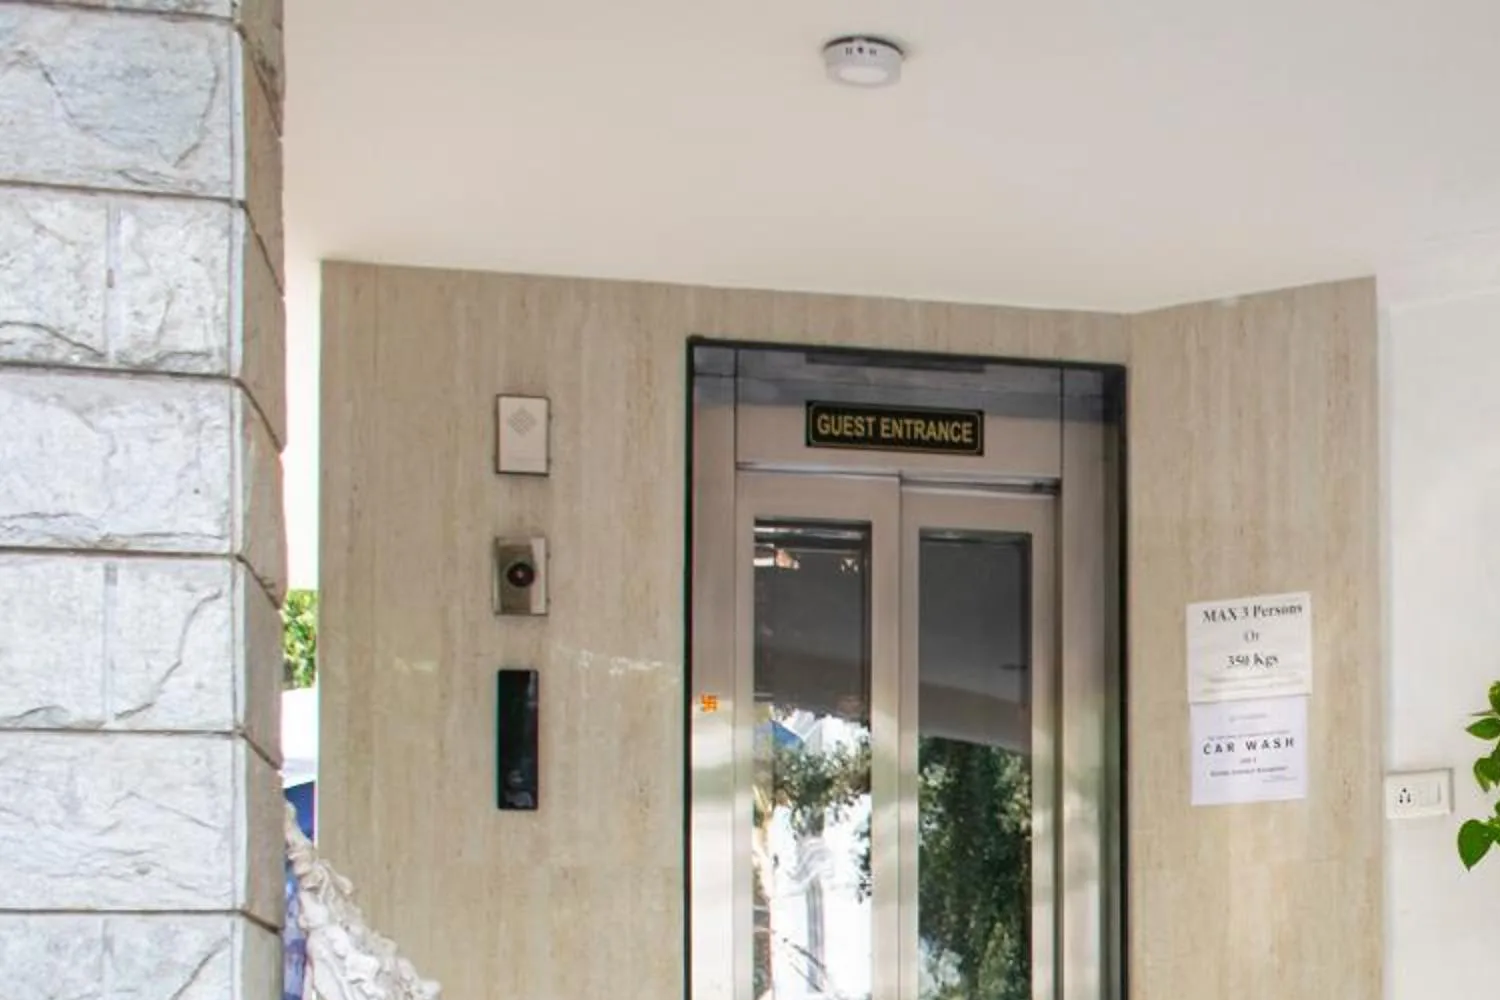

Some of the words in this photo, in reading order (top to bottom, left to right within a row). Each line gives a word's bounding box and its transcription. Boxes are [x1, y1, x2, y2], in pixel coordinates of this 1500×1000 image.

[816, 414, 876, 436] GUEST
[879, 417, 973, 443] ENTRANCE
[1203, 608, 1237, 623] MAX
[1253, 604, 1303, 619] Persons
[1203, 742, 1235, 755] CAR
[1245, 737, 1295, 751] WASH
